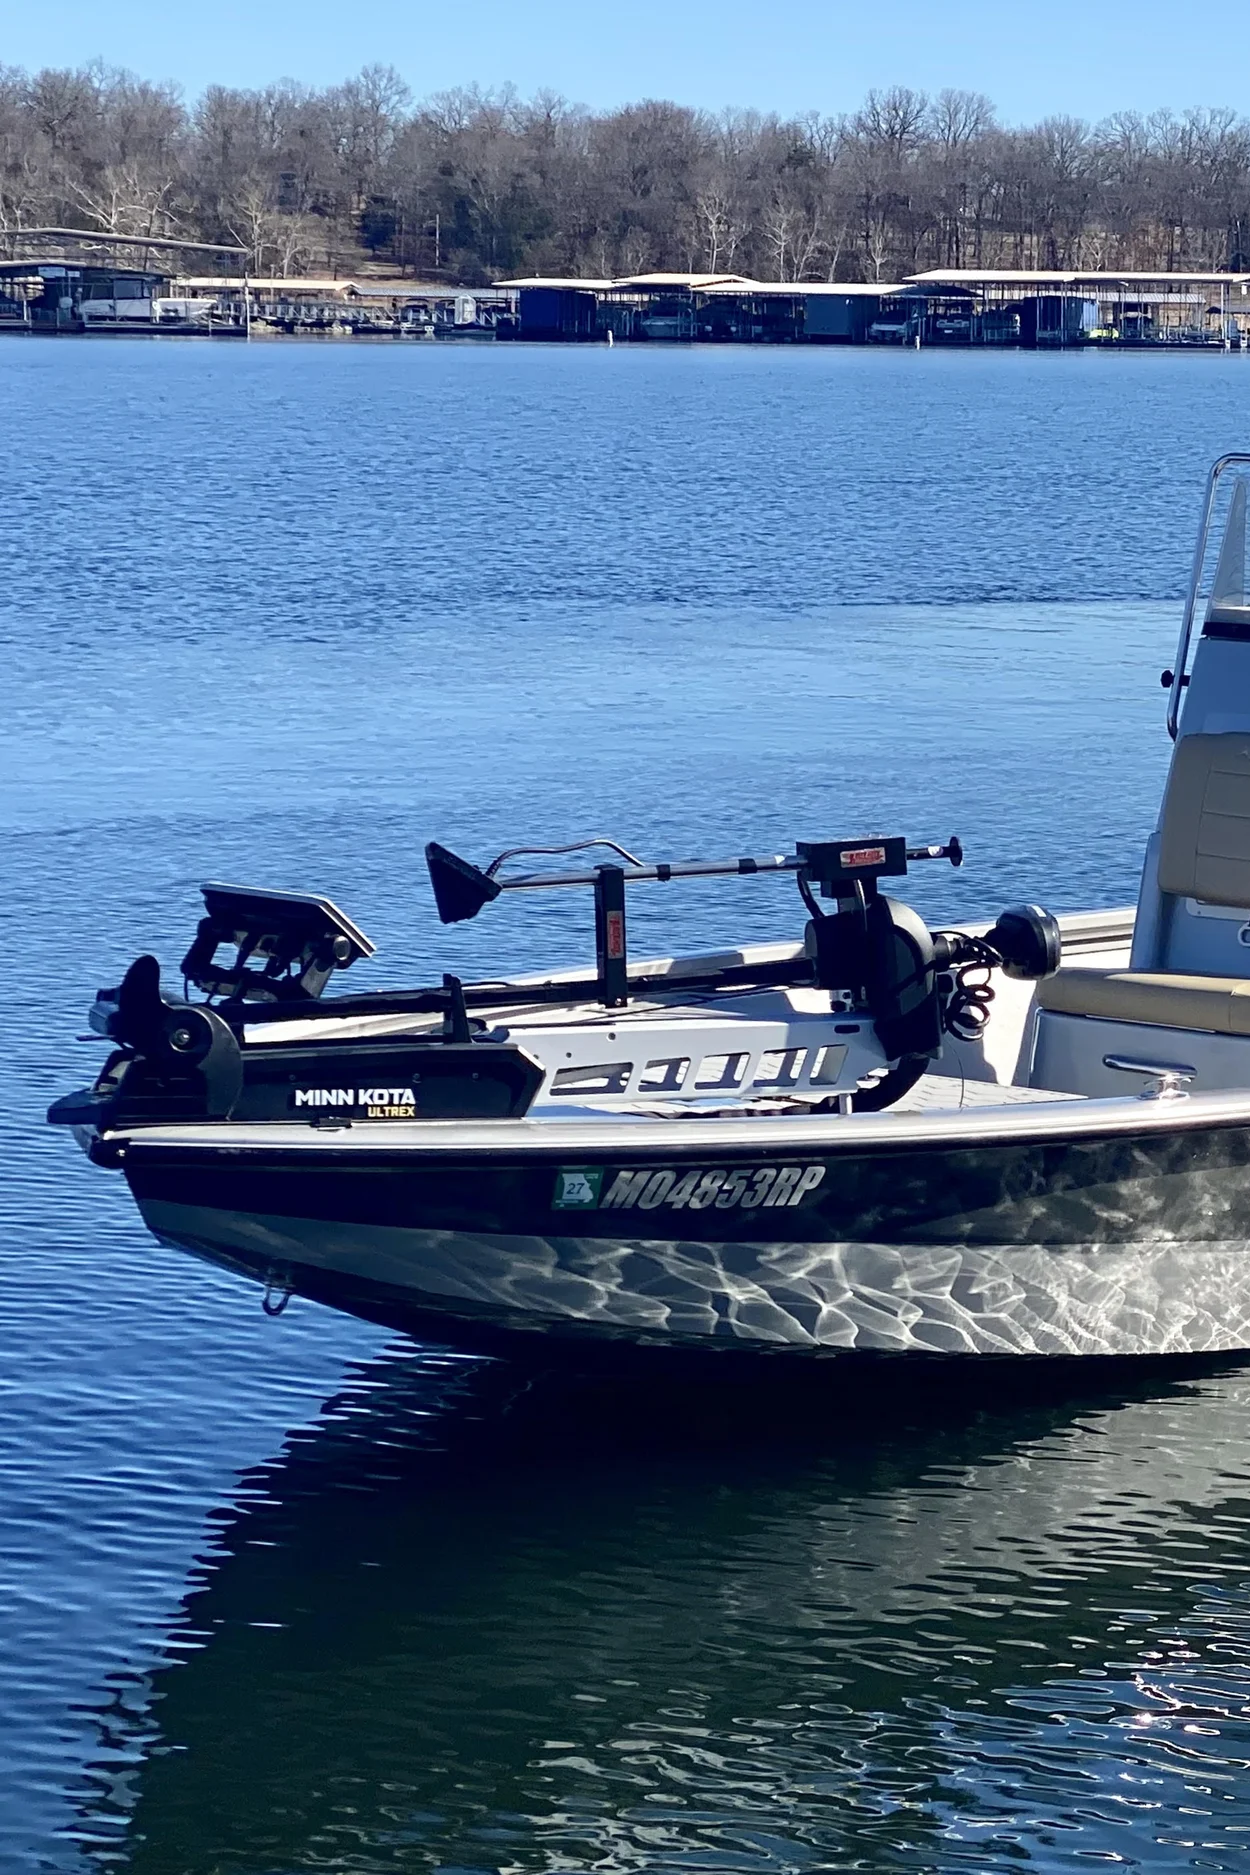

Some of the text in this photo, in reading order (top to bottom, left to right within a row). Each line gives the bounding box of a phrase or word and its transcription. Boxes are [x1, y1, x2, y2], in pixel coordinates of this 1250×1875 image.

[295, 1088, 416, 1106] MINN KOTA
[367, 1105, 415, 1117] ULTREX
[566, 1182, 585, 1195] 27
